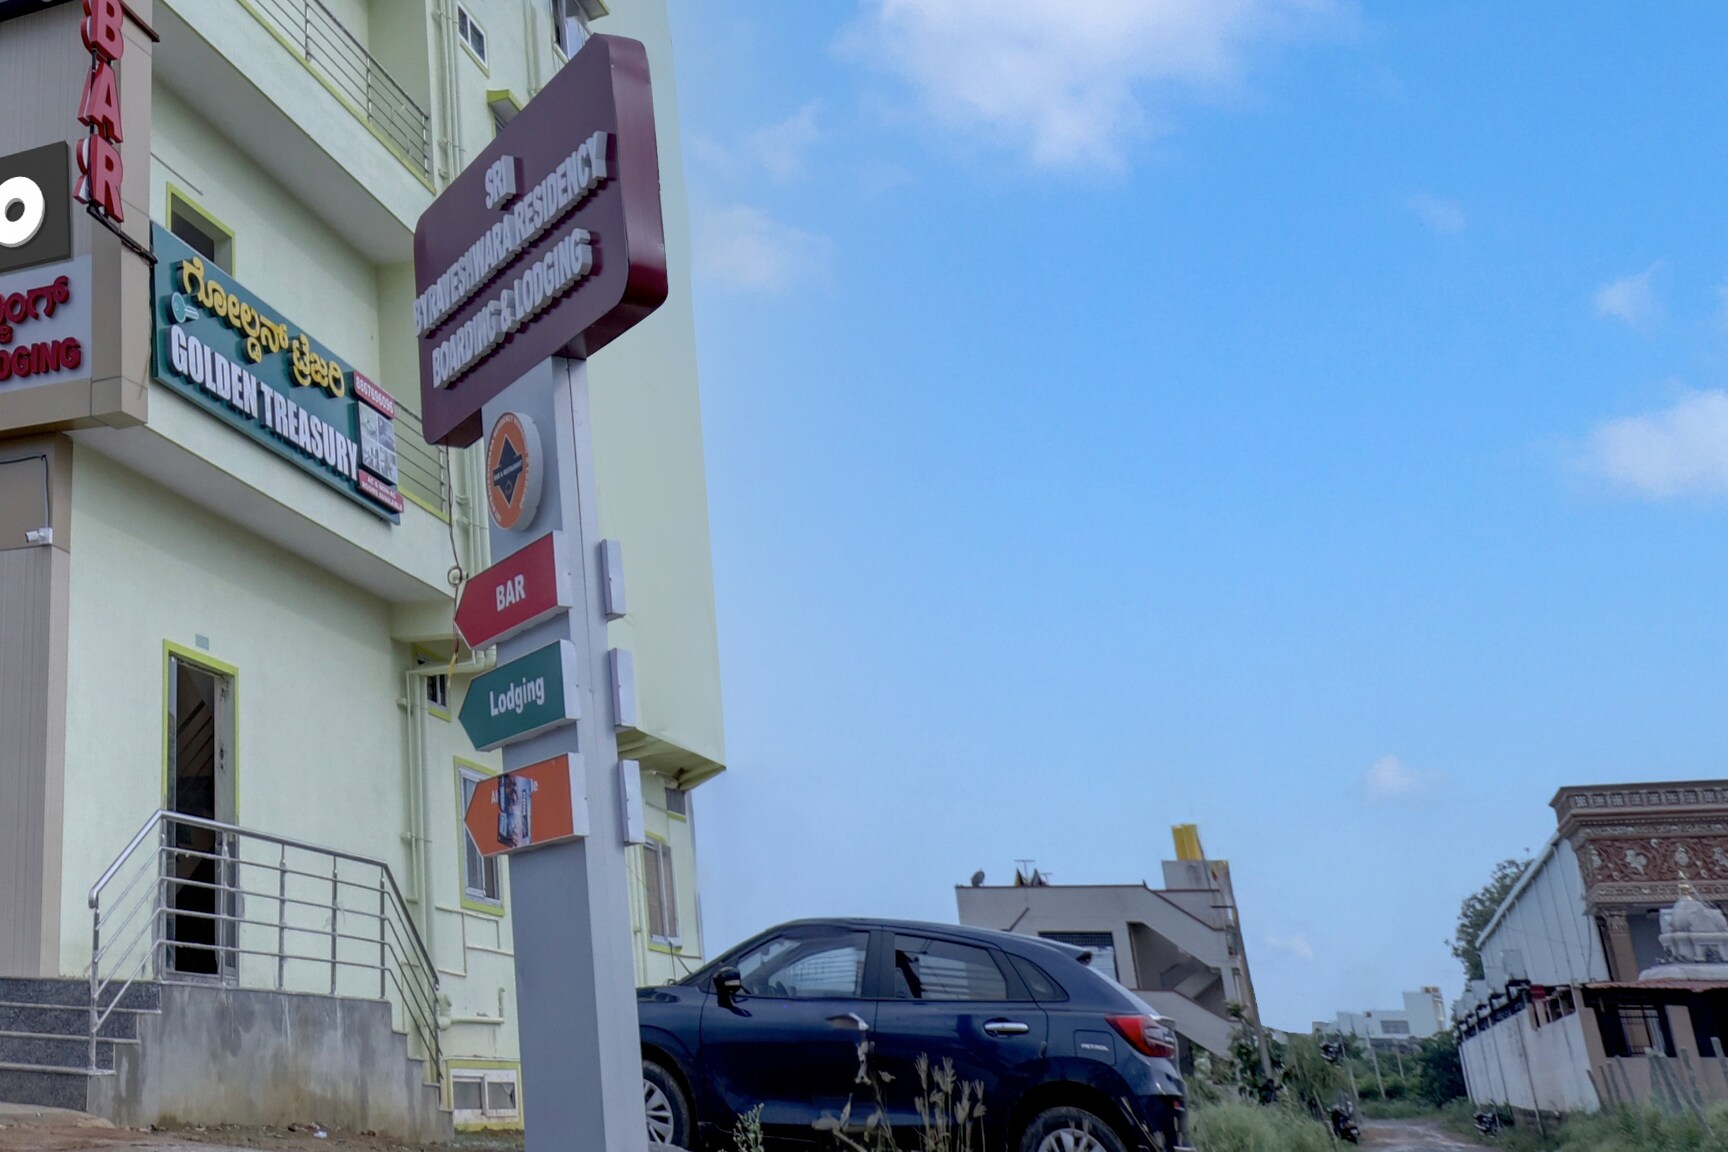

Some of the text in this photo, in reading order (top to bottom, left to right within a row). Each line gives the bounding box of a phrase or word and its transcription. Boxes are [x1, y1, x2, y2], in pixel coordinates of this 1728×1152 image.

[413, 130, 607, 338] BYRAVESHWARA RESIDENCY
[485, 154, 517, 210] SRI
[432, 228, 592, 389] BOARDING & LODGING
[170, 324, 358, 483] GOLDEN TREASURY
[495, 573, 526, 612] BAR
[489, 674, 545, 717] Lodging
